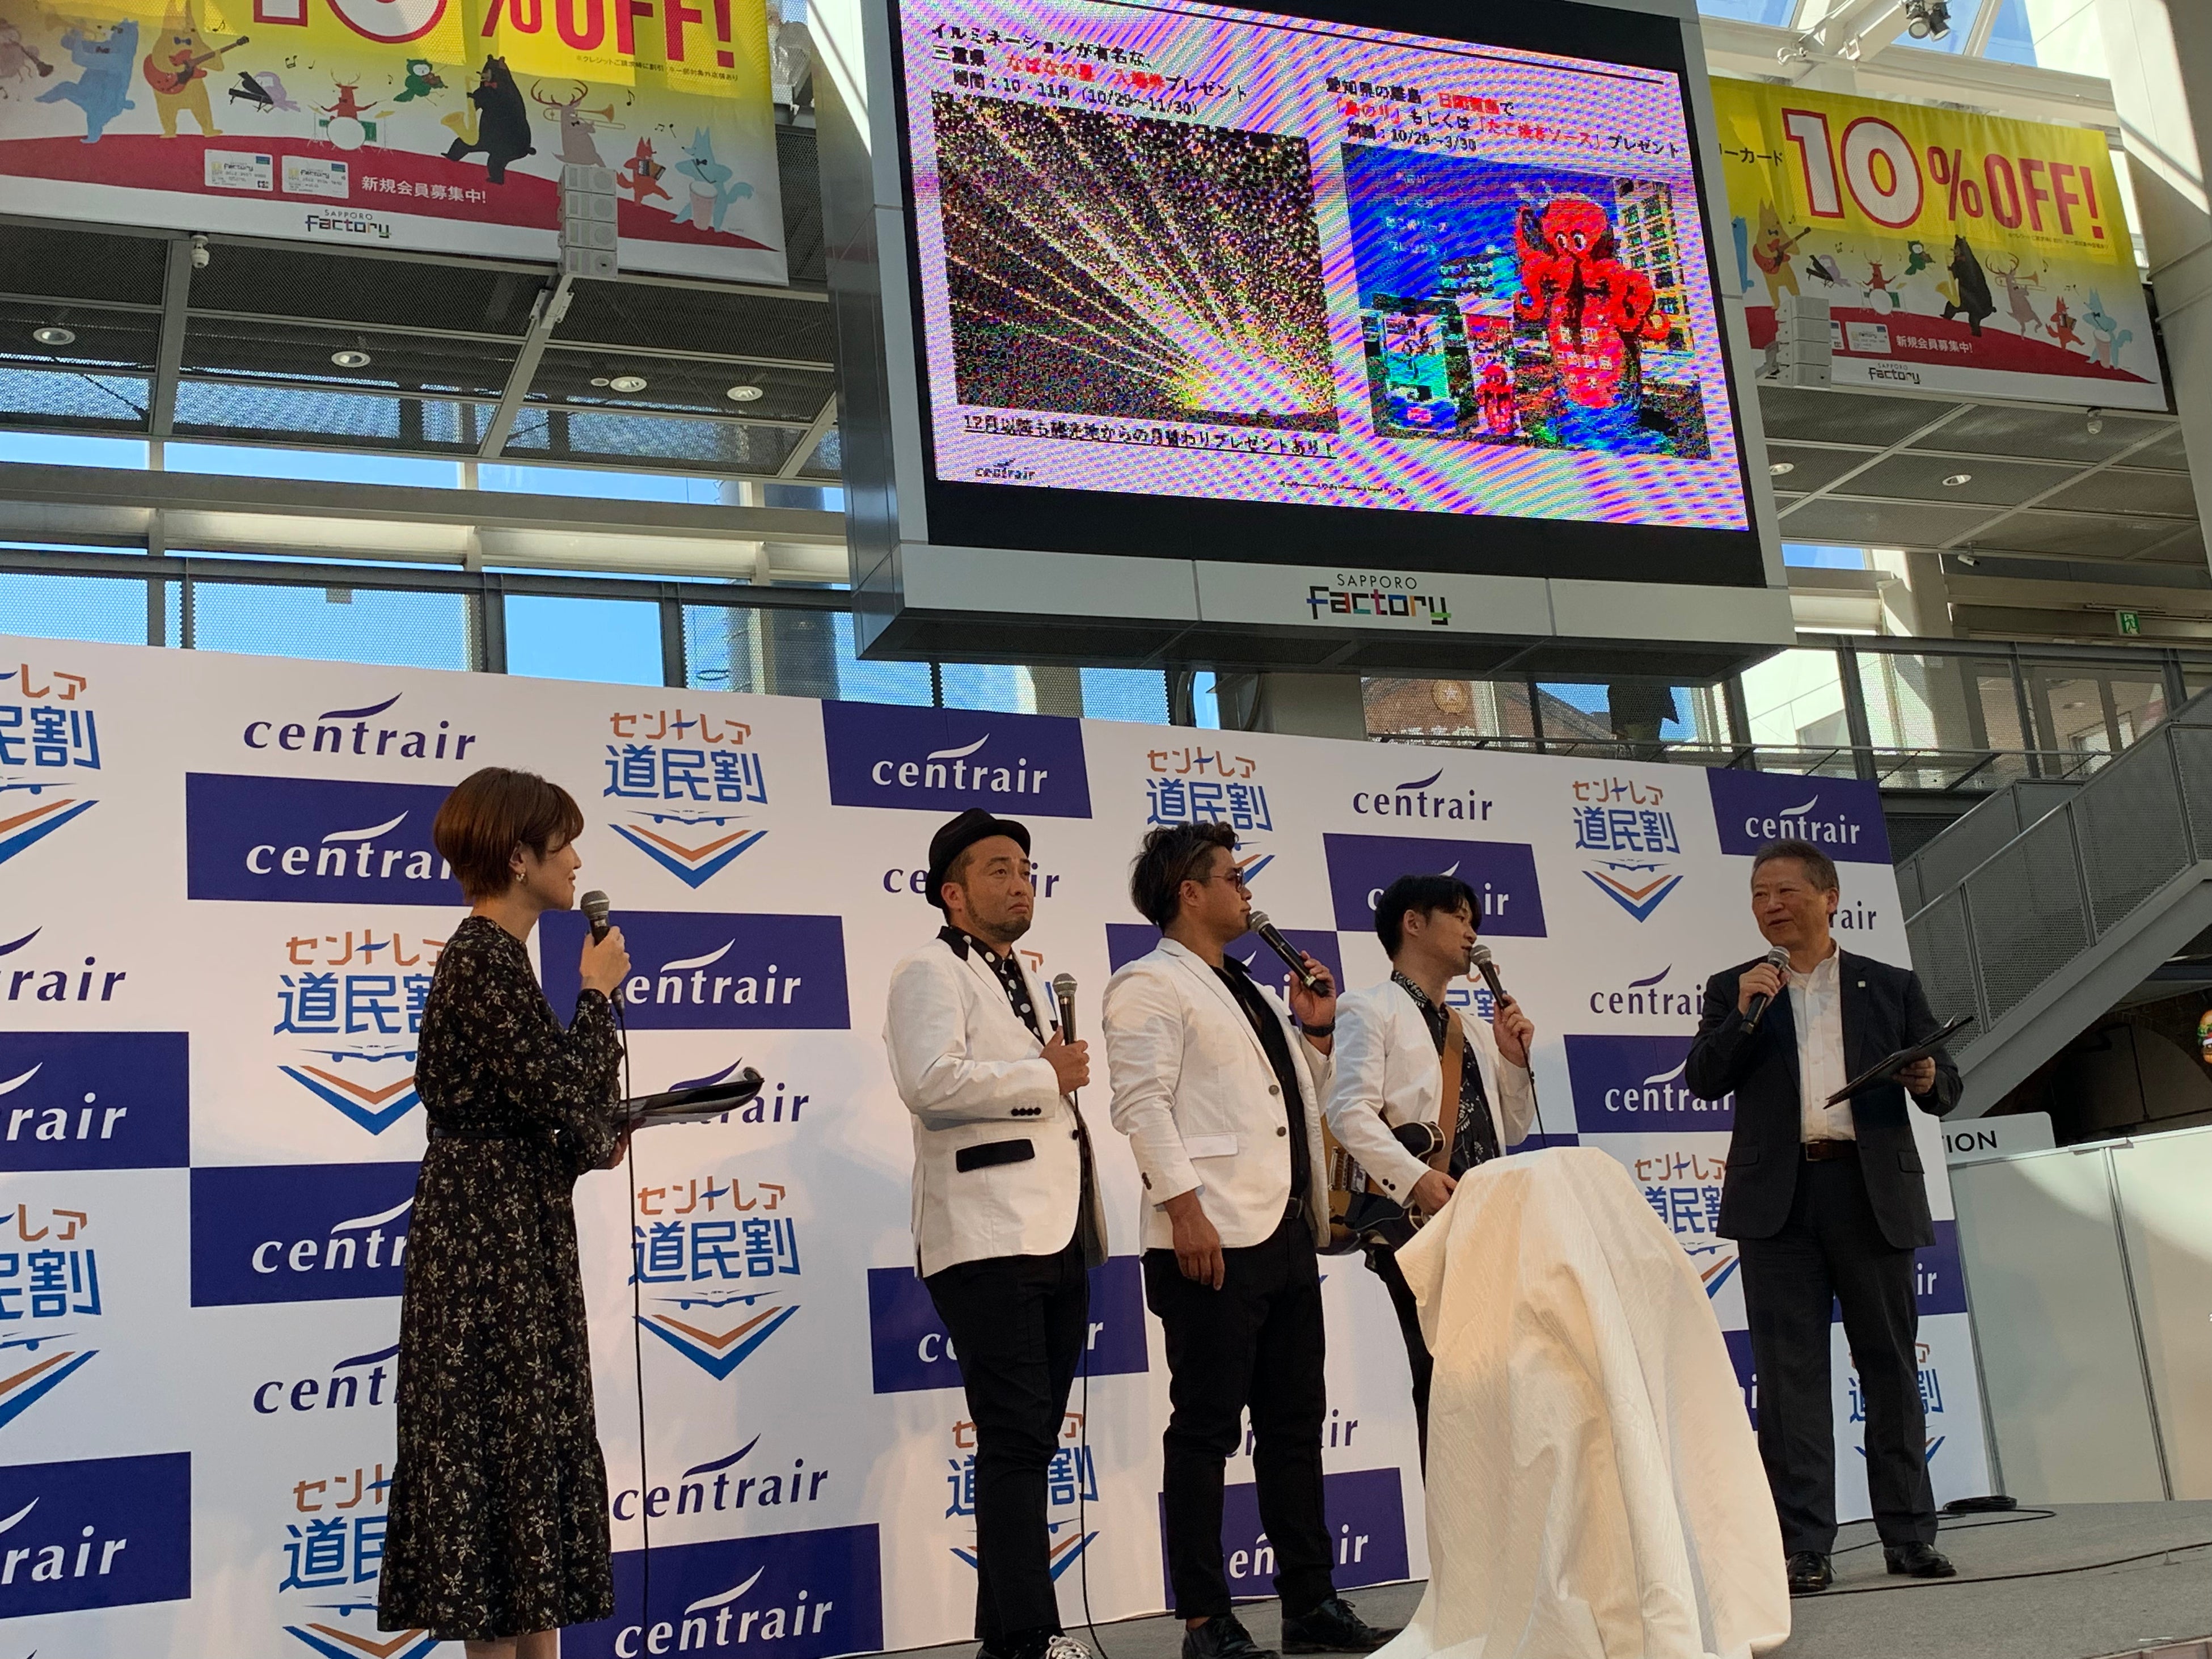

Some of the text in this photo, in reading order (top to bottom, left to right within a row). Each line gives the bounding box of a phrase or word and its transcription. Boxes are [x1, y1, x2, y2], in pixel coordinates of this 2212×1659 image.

[1719, 140, 1783, 166] ーカード
[1782, 107, 2105, 240] 10%OFF!
[324, 209, 373, 221] SAPPORO
[1336, 573, 1417, 590] SAPPORO
[243, 719, 476, 761] centrair
[610, 709, 752, 745] セントレア
[603, 744, 769, 805] 道民割
[871, 758, 1048, 794] centrair
[1147, 746, 1256, 779] セントレア
[1353, 790, 1492, 821] centrair
[1572, 776, 1664, 806] セントレア
[1572, 806, 1681, 855] 道民割
[1745, 814, 1861, 845] centrair
[0, 956, 127, 1002] rair
[626, 965, 801, 1005] entrair
[1590, 984, 1702, 1015] centrai
[6, 1092, 127, 1141] rair
[1942, 1130, 1998, 1154] ION
[1635, 1151, 1726, 1181] セントレア
[638, 1176, 786, 1215] セントレア
[252, 1229, 408, 1274] centr
[628, 1217, 801, 1286] 道民割
[253, 1366, 399, 1414] cent
[613, 1458, 828, 1521] centrair
[1, 1525, 127, 1585] rair
[615, 1589, 833, 1659] centrair
